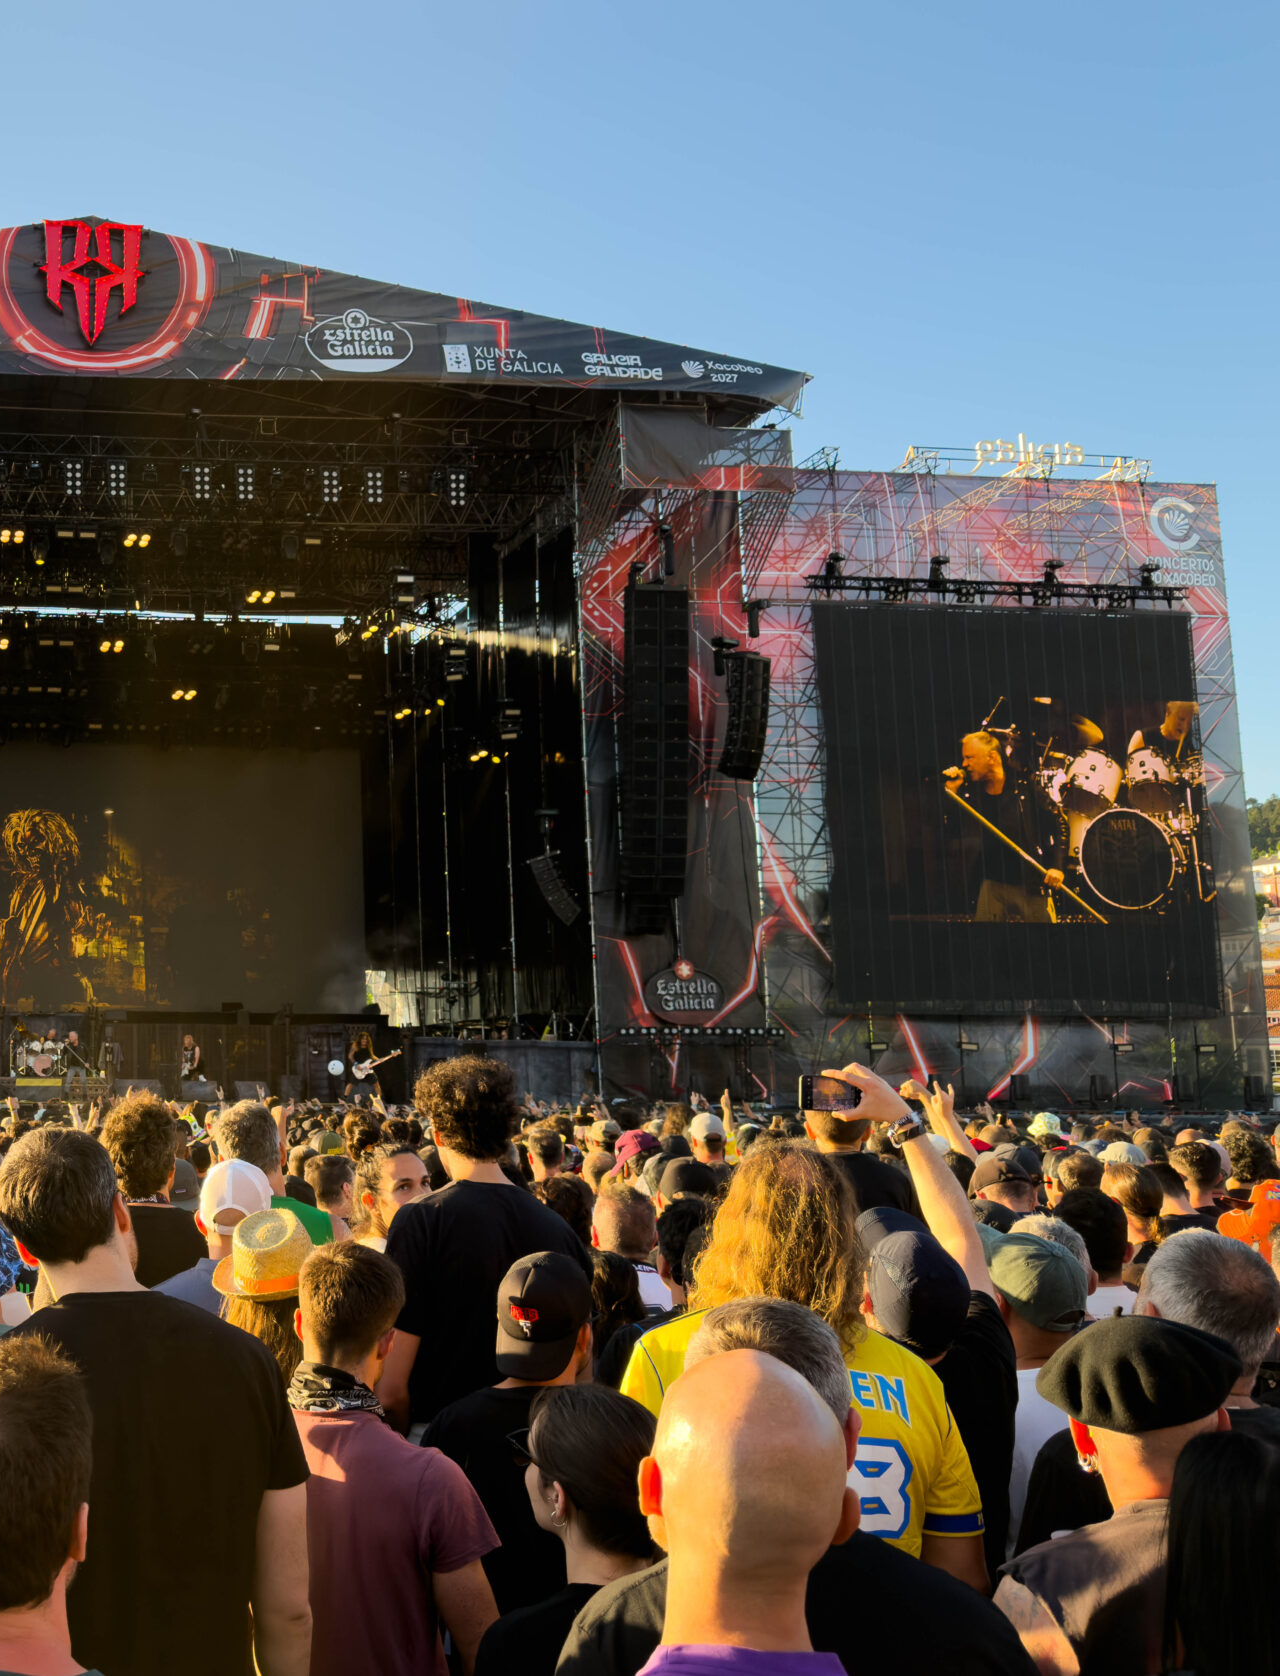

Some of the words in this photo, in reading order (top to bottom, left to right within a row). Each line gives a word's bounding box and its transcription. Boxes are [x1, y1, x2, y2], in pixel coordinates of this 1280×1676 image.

[327, 340, 394, 356] Galicia
[473, 346, 528, 360] XUNTA
[475, 359, 496, 371] DE
[500, 360, 564, 374] GALICIA
[581, 352, 642, 366] GALICIA
[584, 365, 663, 380] CALIDADE
[705, 360, 763, 375] Xacobeo
[710, 373, 738, 383] 2027
[1166, 572, 1216, 586] XACOBEO
[656, 979, 718, 995] Estrella
[661, 995, 715, 1011] Galicia
[847, 1369, 912, 1429] EN
